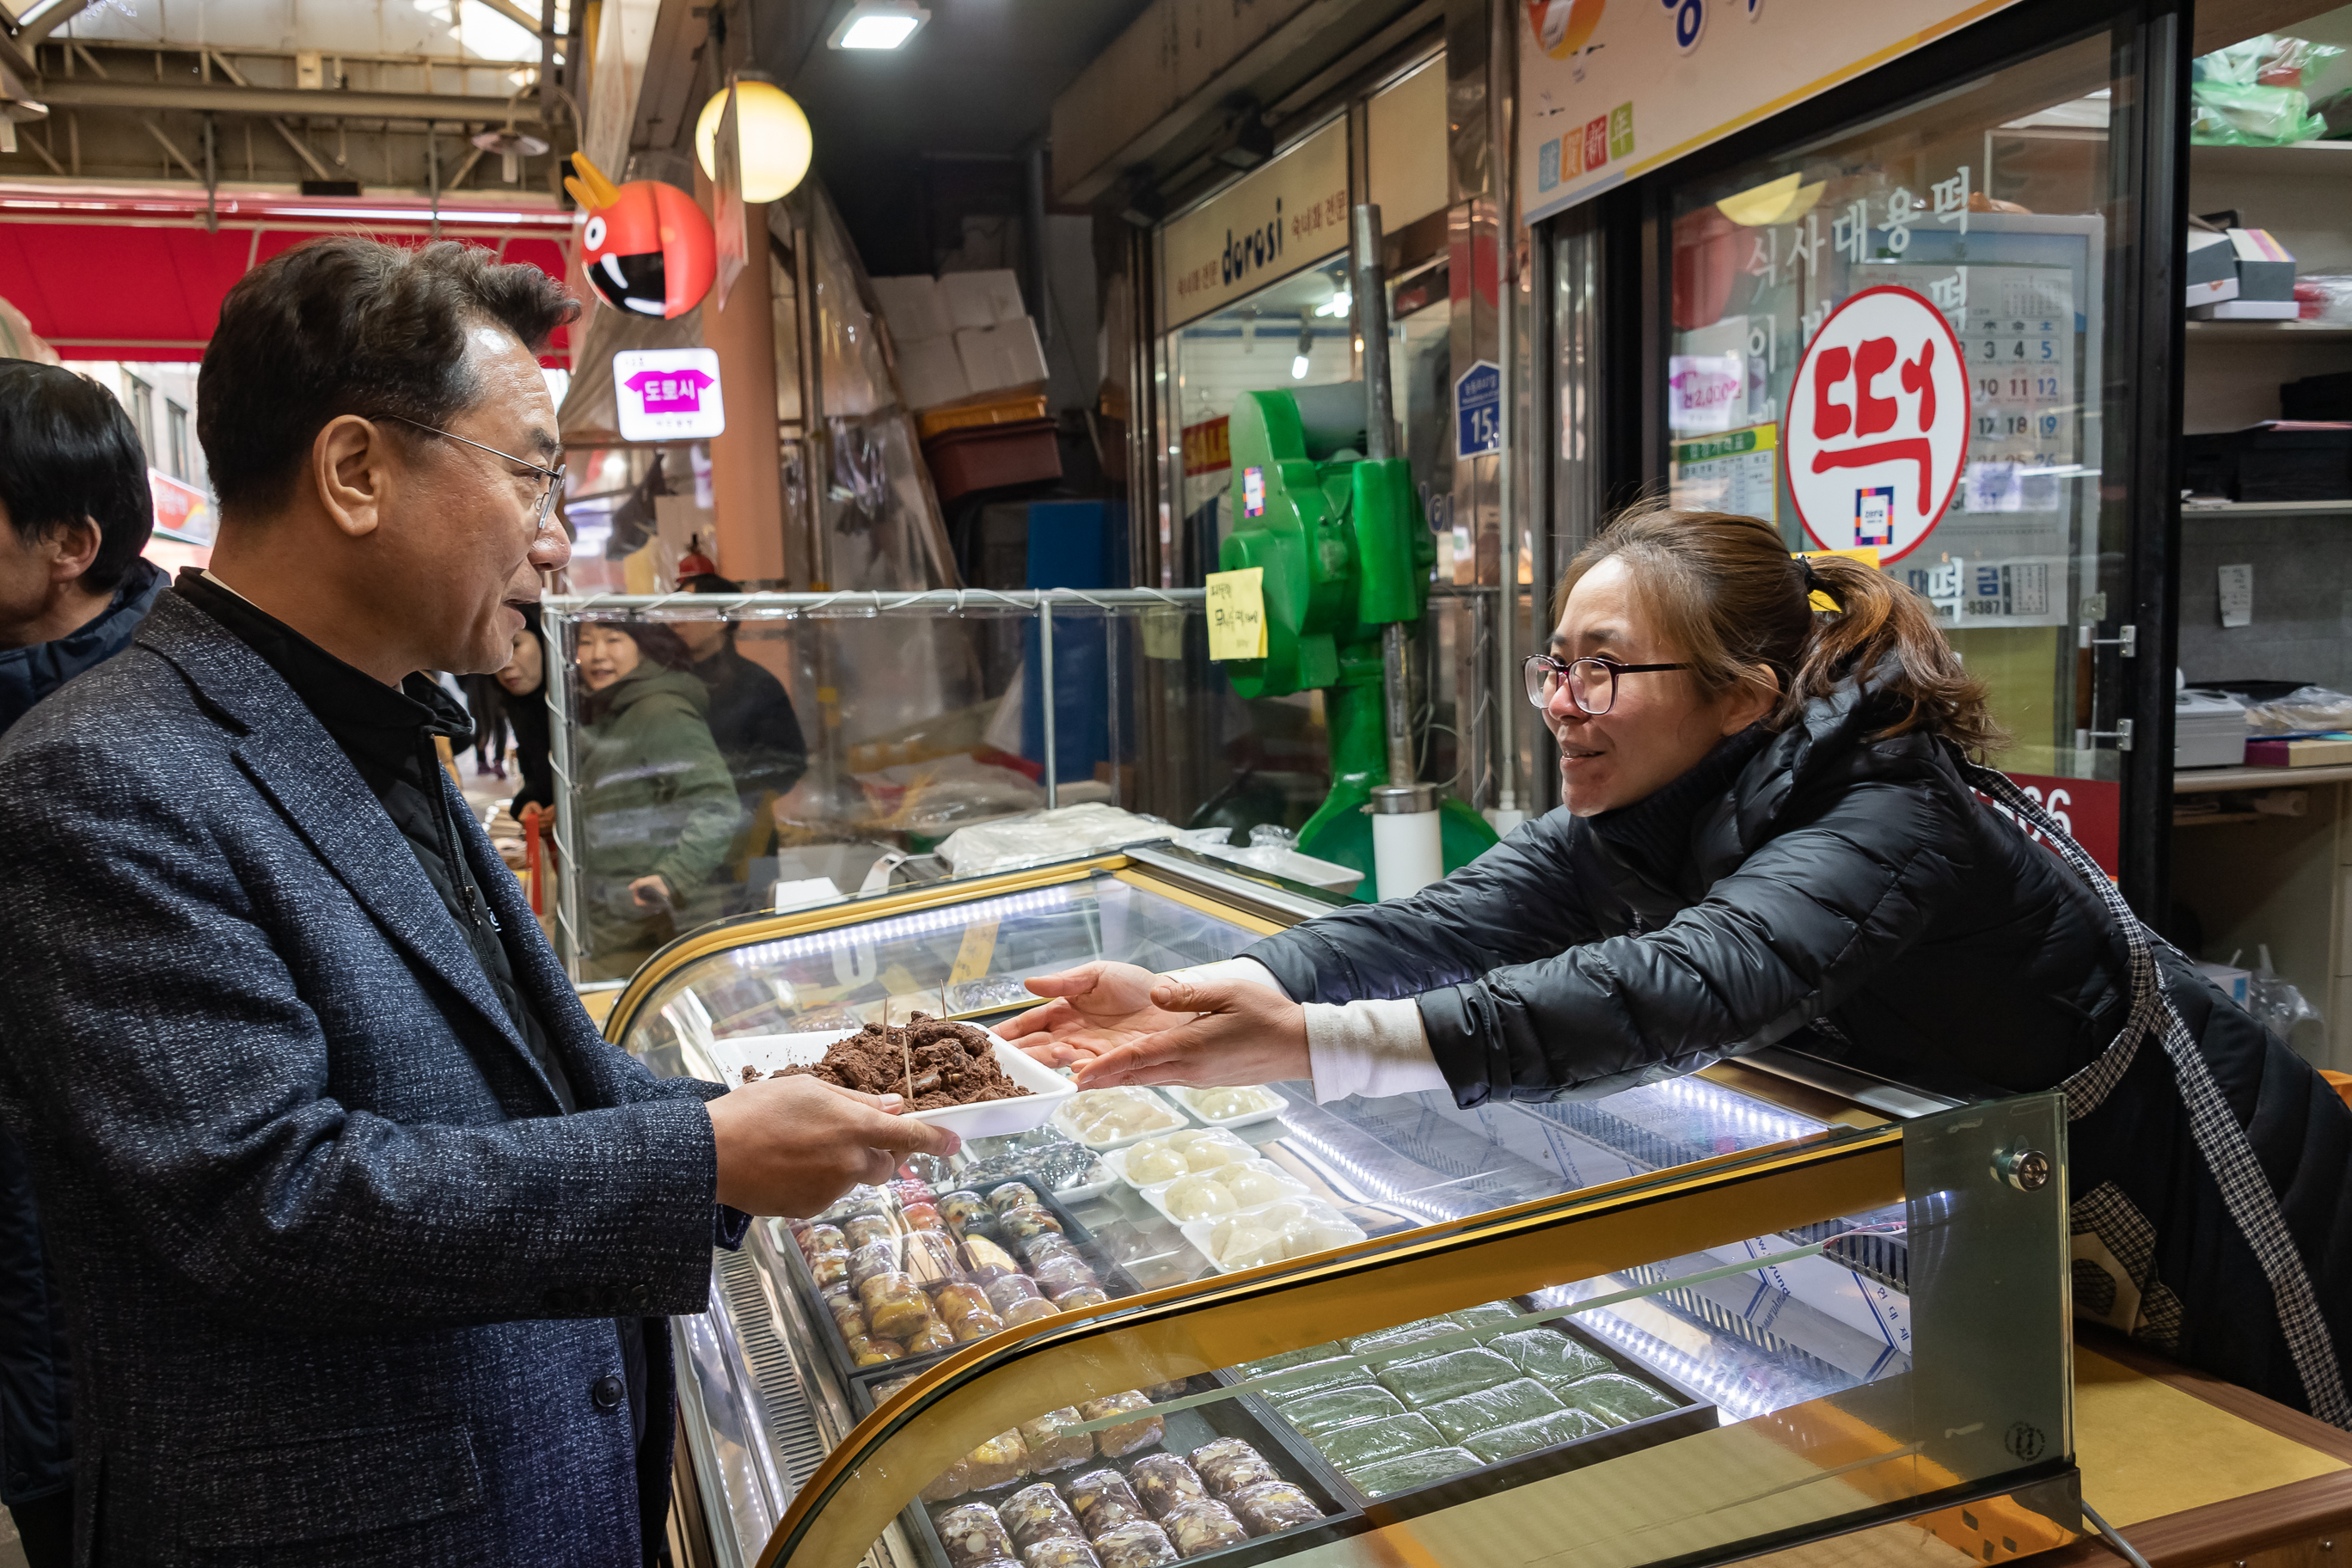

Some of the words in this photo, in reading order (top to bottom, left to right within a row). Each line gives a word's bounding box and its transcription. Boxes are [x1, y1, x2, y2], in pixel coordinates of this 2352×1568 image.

[1222, 197, 1283, 286] dorosi
[1983, 341, 1996, 359] 3
[2013, 340, 2025, 359] 4
[2040, 340, 2052, 359] 5
[644, 378, 695, 401] 도로시
[1979, 378, 1999, 396] 10
[2009, 378, 2028, 396] 11
[2037, 378, 2057, 395] 12
[1471, 407, 1493, 444] 15
[1812, 336, 1935, 517] 떡
[1978, 417, 1994, 434] 17
[2007, 417, 2027, 433] 18
[2038, 415, 2057, 433] 19
